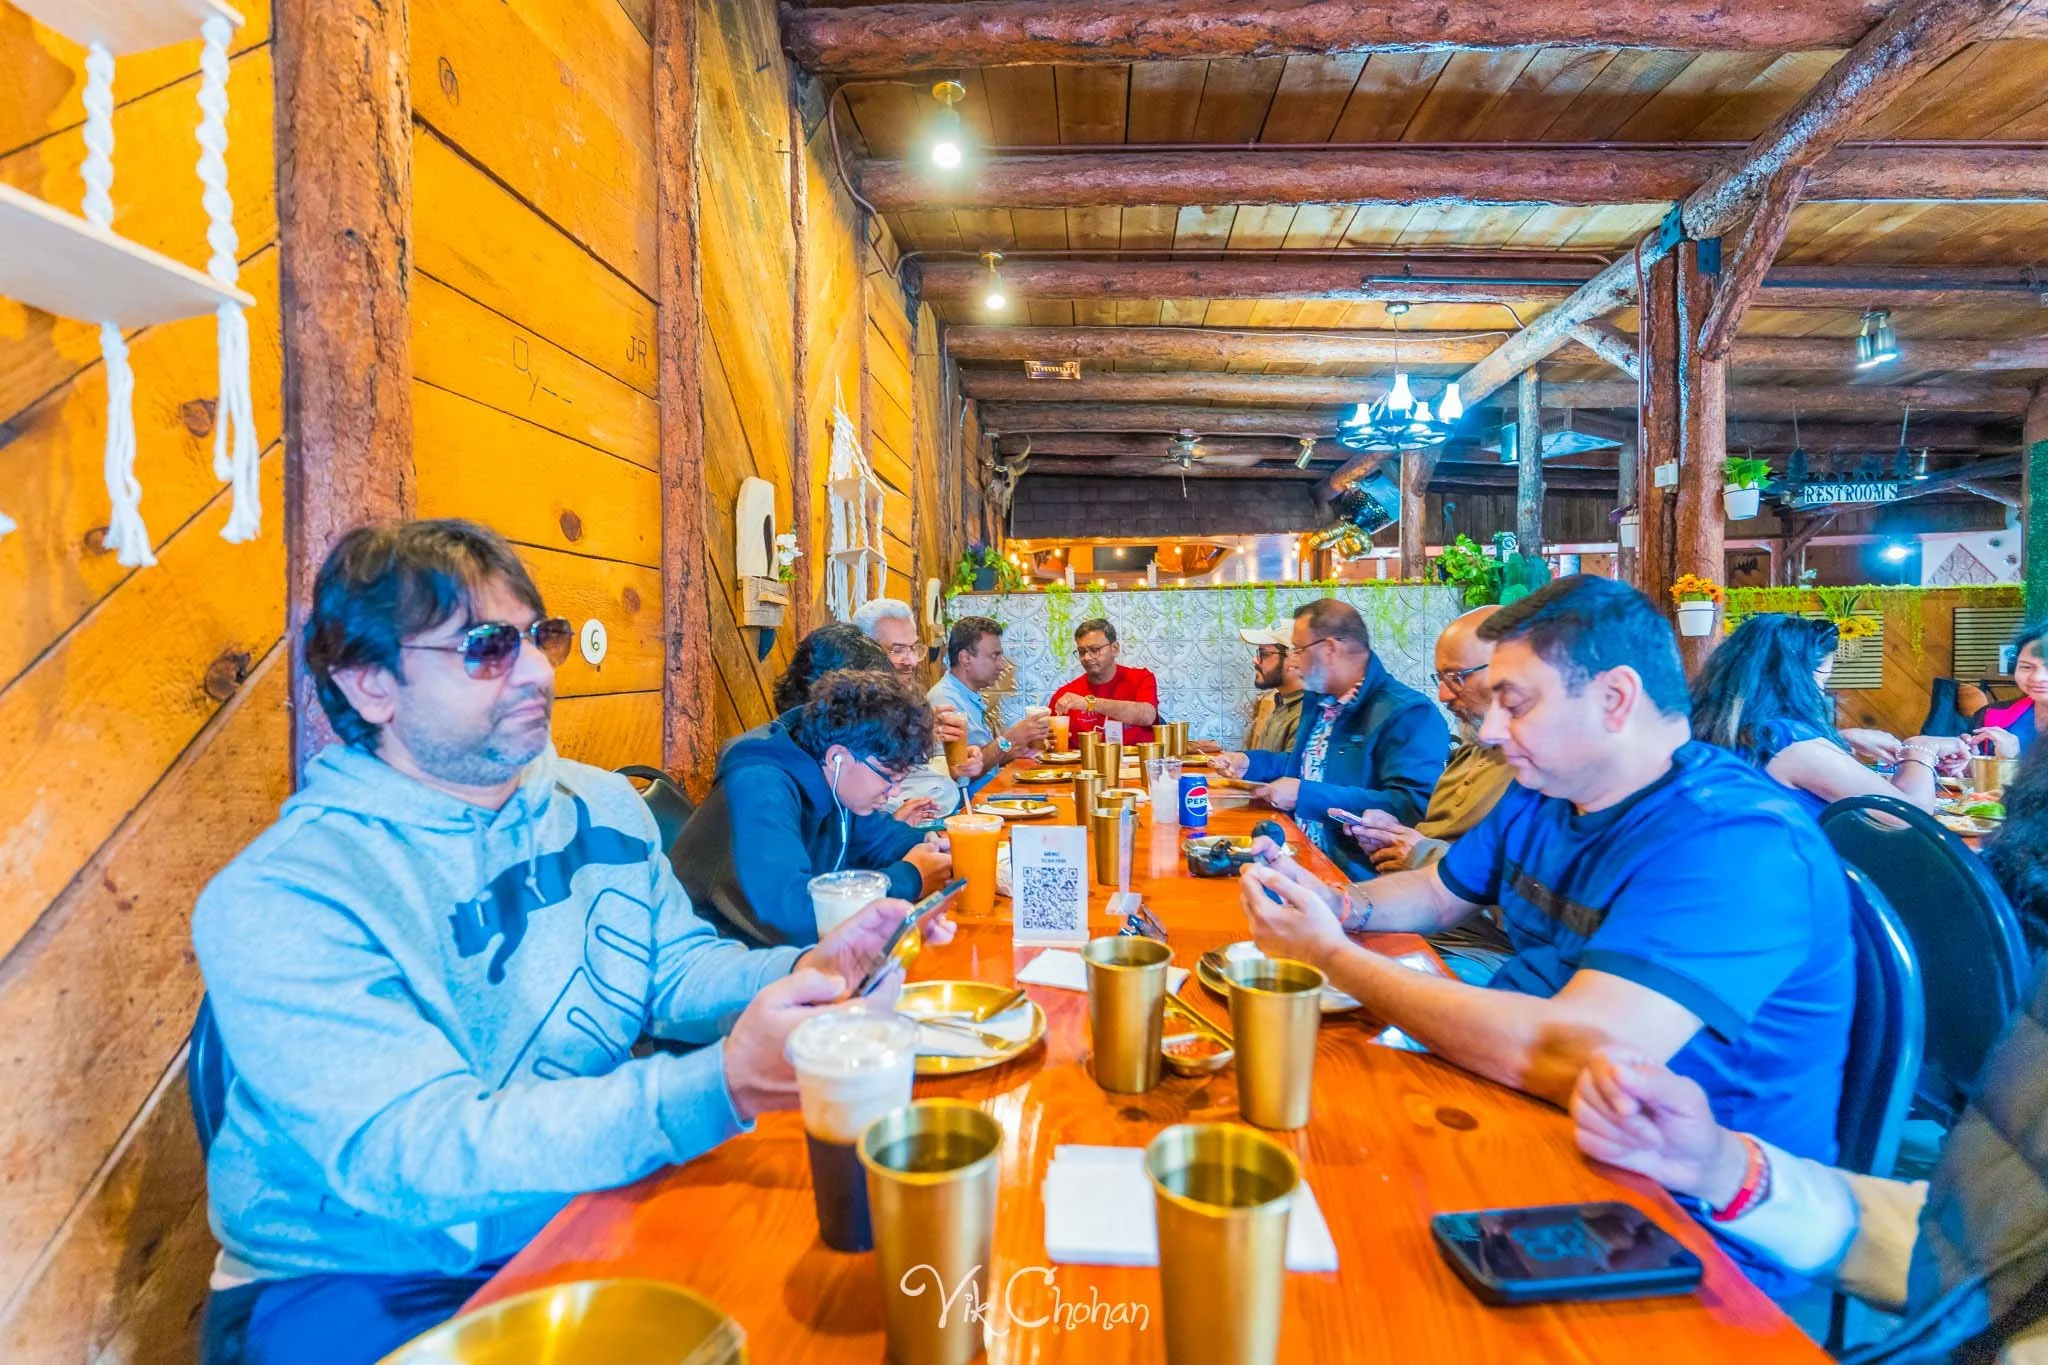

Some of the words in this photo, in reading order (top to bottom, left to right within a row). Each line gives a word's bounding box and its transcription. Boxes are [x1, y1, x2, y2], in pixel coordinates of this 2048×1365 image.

[1805, 484, 1898, 503] RESTROOMS
[591, 629, 600, 651] 6
[1187, 797, 1207, 805] PEPS
